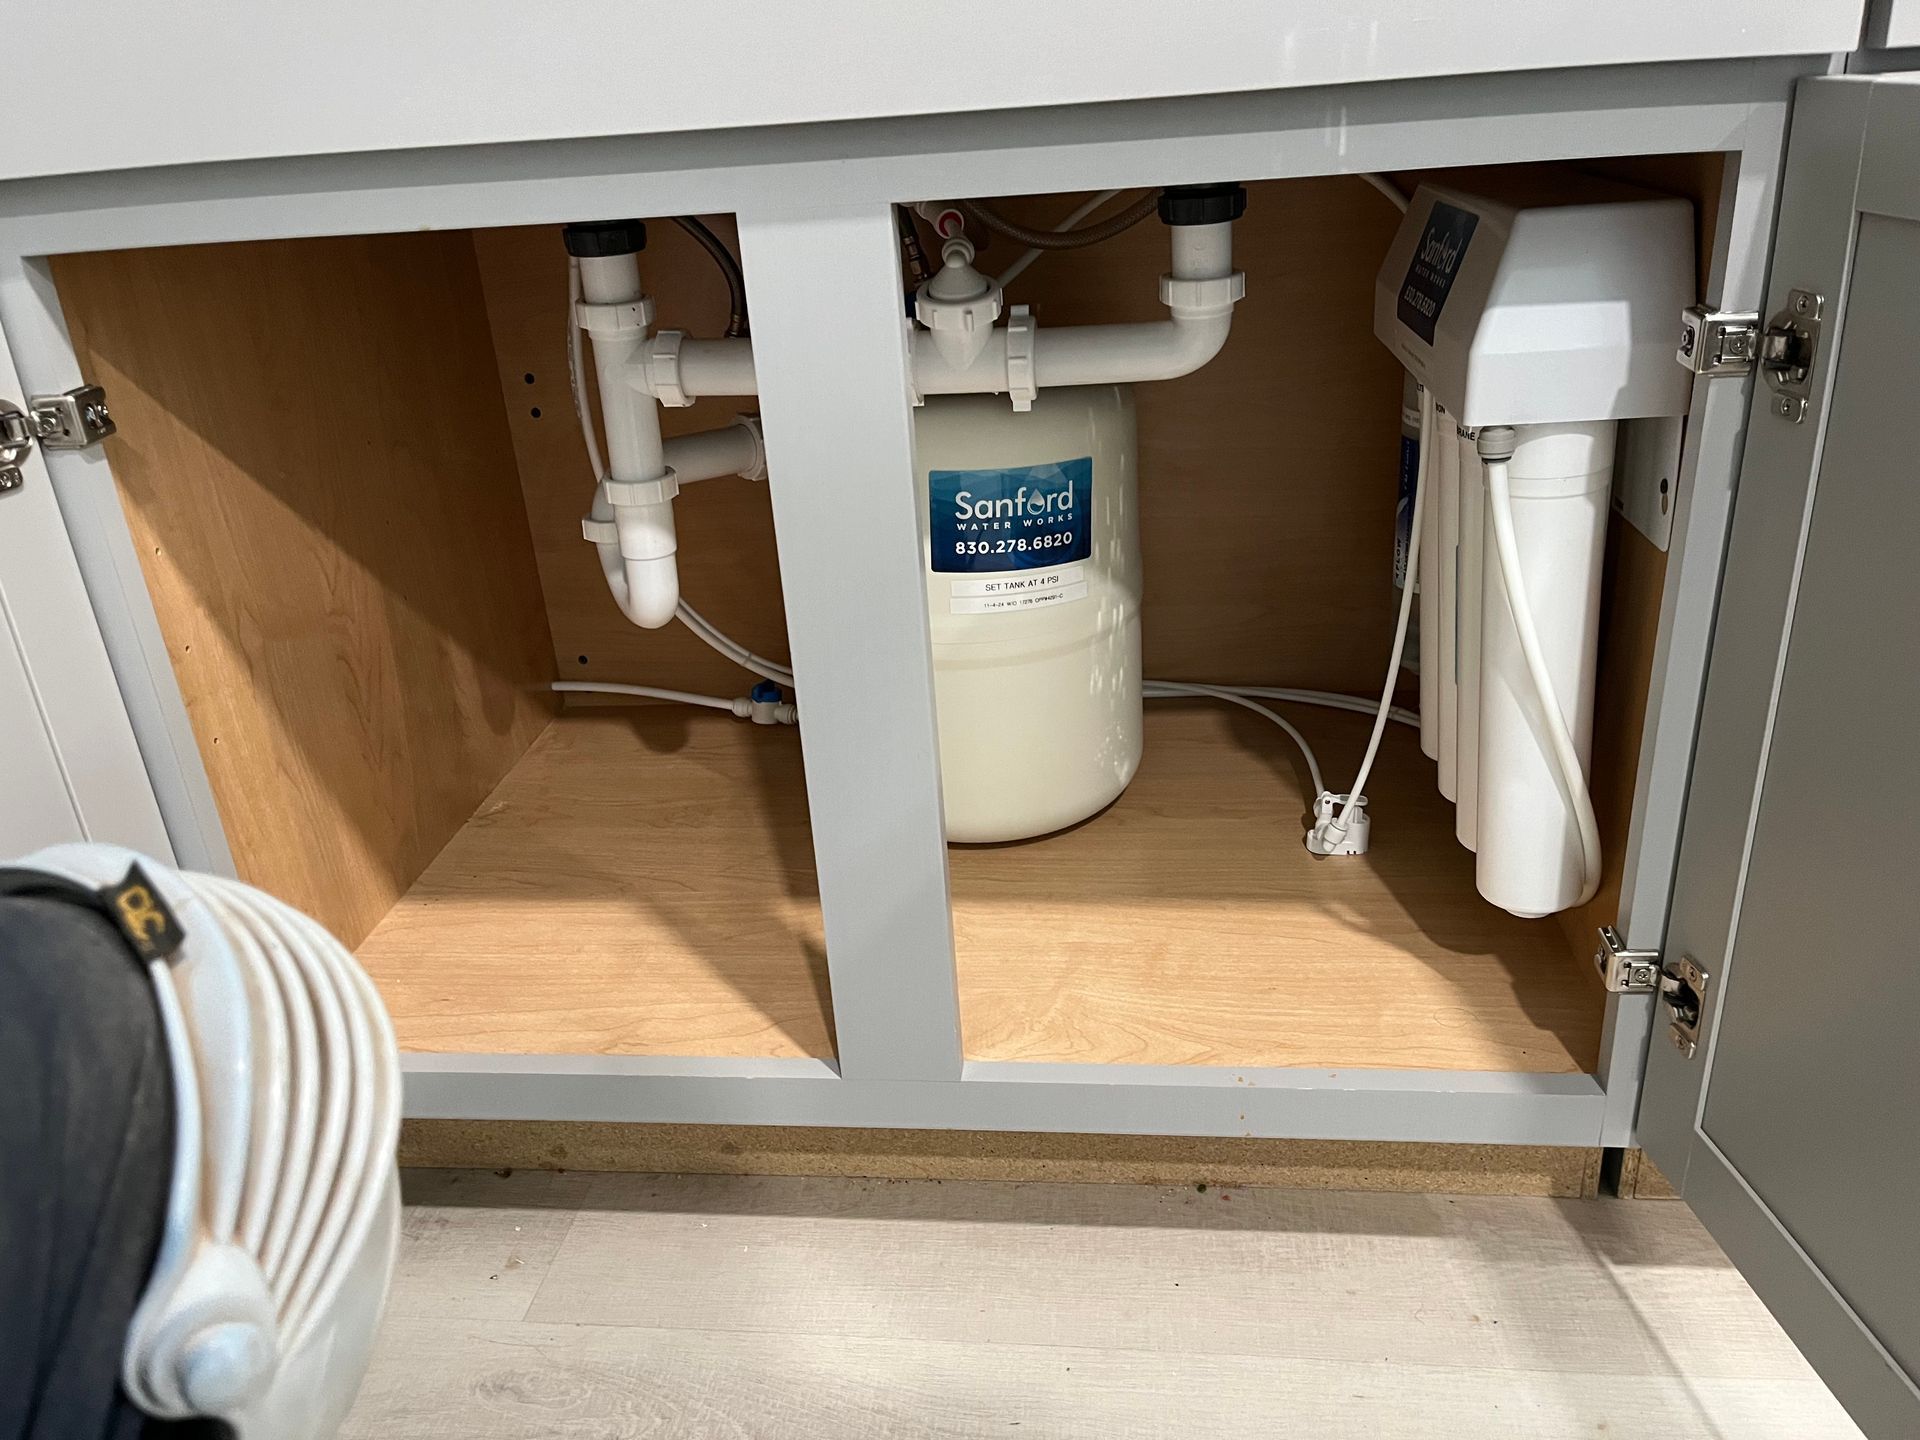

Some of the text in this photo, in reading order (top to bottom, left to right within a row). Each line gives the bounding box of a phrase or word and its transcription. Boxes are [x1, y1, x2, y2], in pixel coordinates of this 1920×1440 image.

[955, 480, 1073, 520] Sanford
[956, 513, 1073, 531] WATER WORKS
[955, 531, 1073, 555] 830.278.6820
[985, 583, 1001, 592] SET
[1004, 581, 1026, 590] TANK
[1028, 579, 1038, 587] AT
[1047, 575, 1059, 584] PSI
